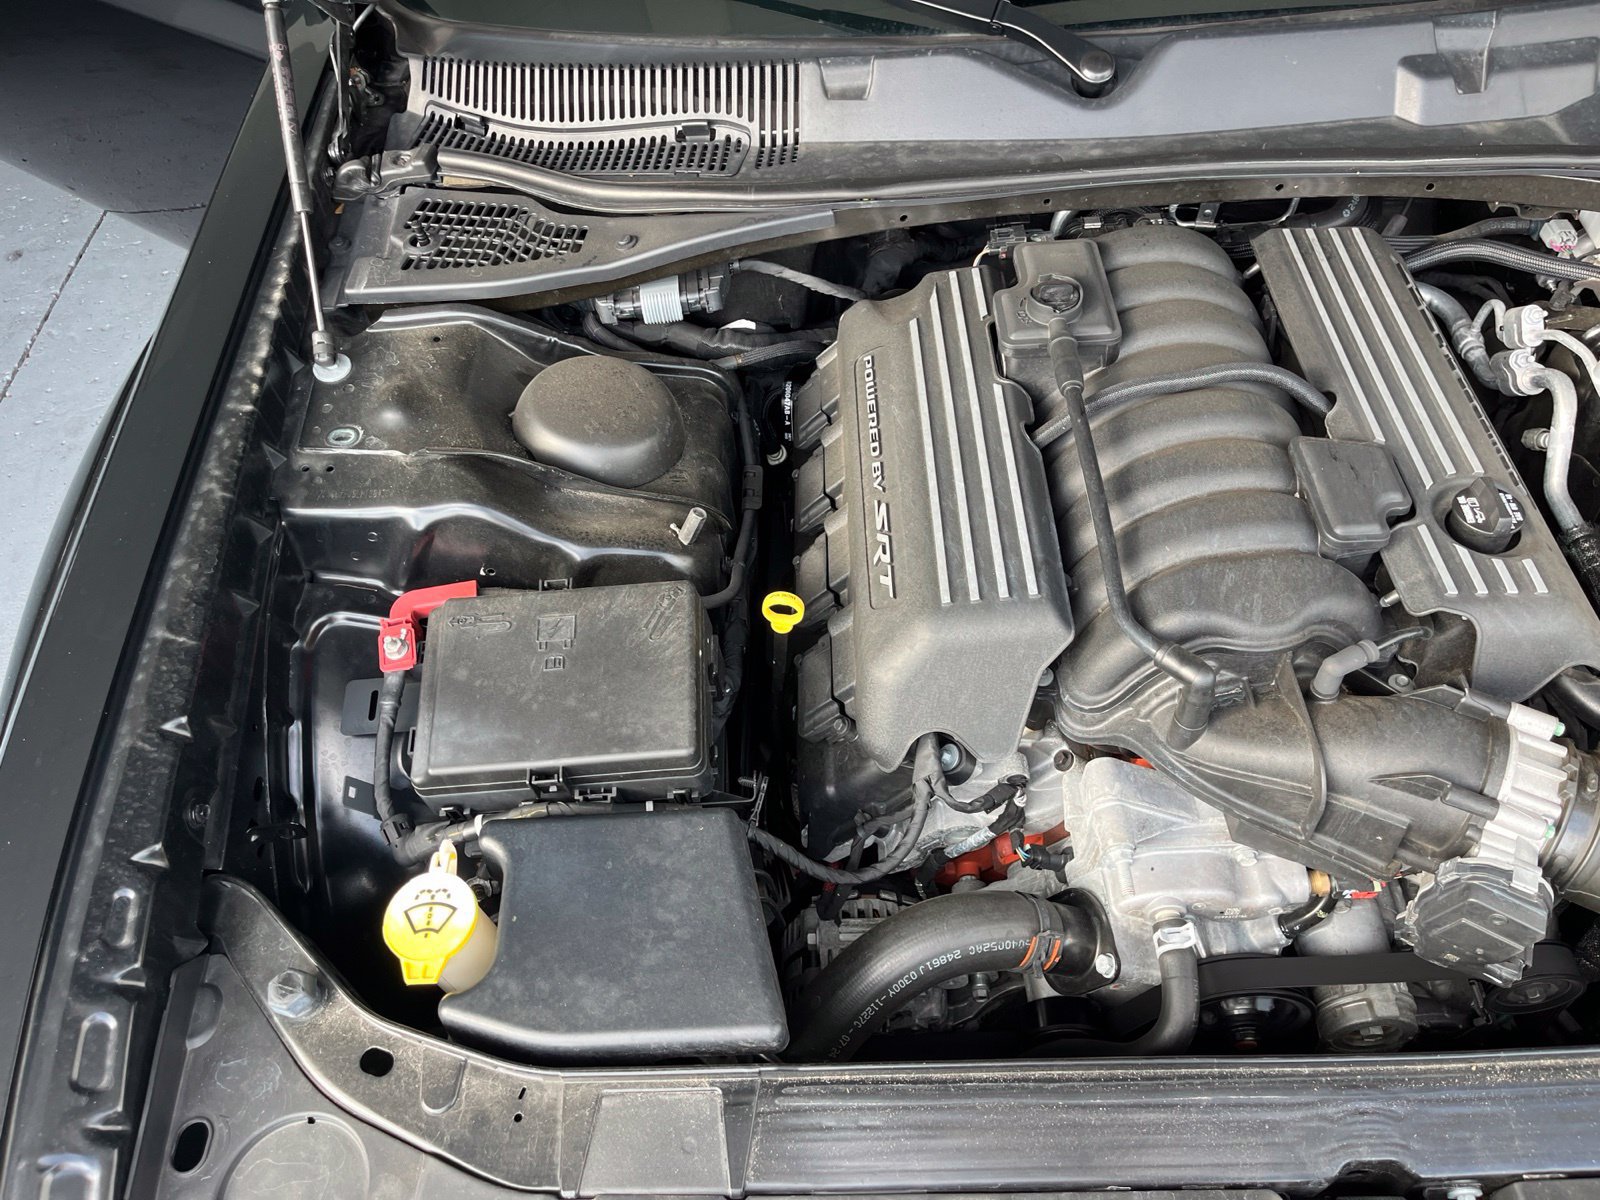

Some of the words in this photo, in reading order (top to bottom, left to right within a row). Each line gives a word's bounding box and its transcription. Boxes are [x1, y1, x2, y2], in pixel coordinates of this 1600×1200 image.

[863, 354, 881, 457] POWERED
[872, 461, 885, 493] BY
[874, 499, 895, 599] SRT
